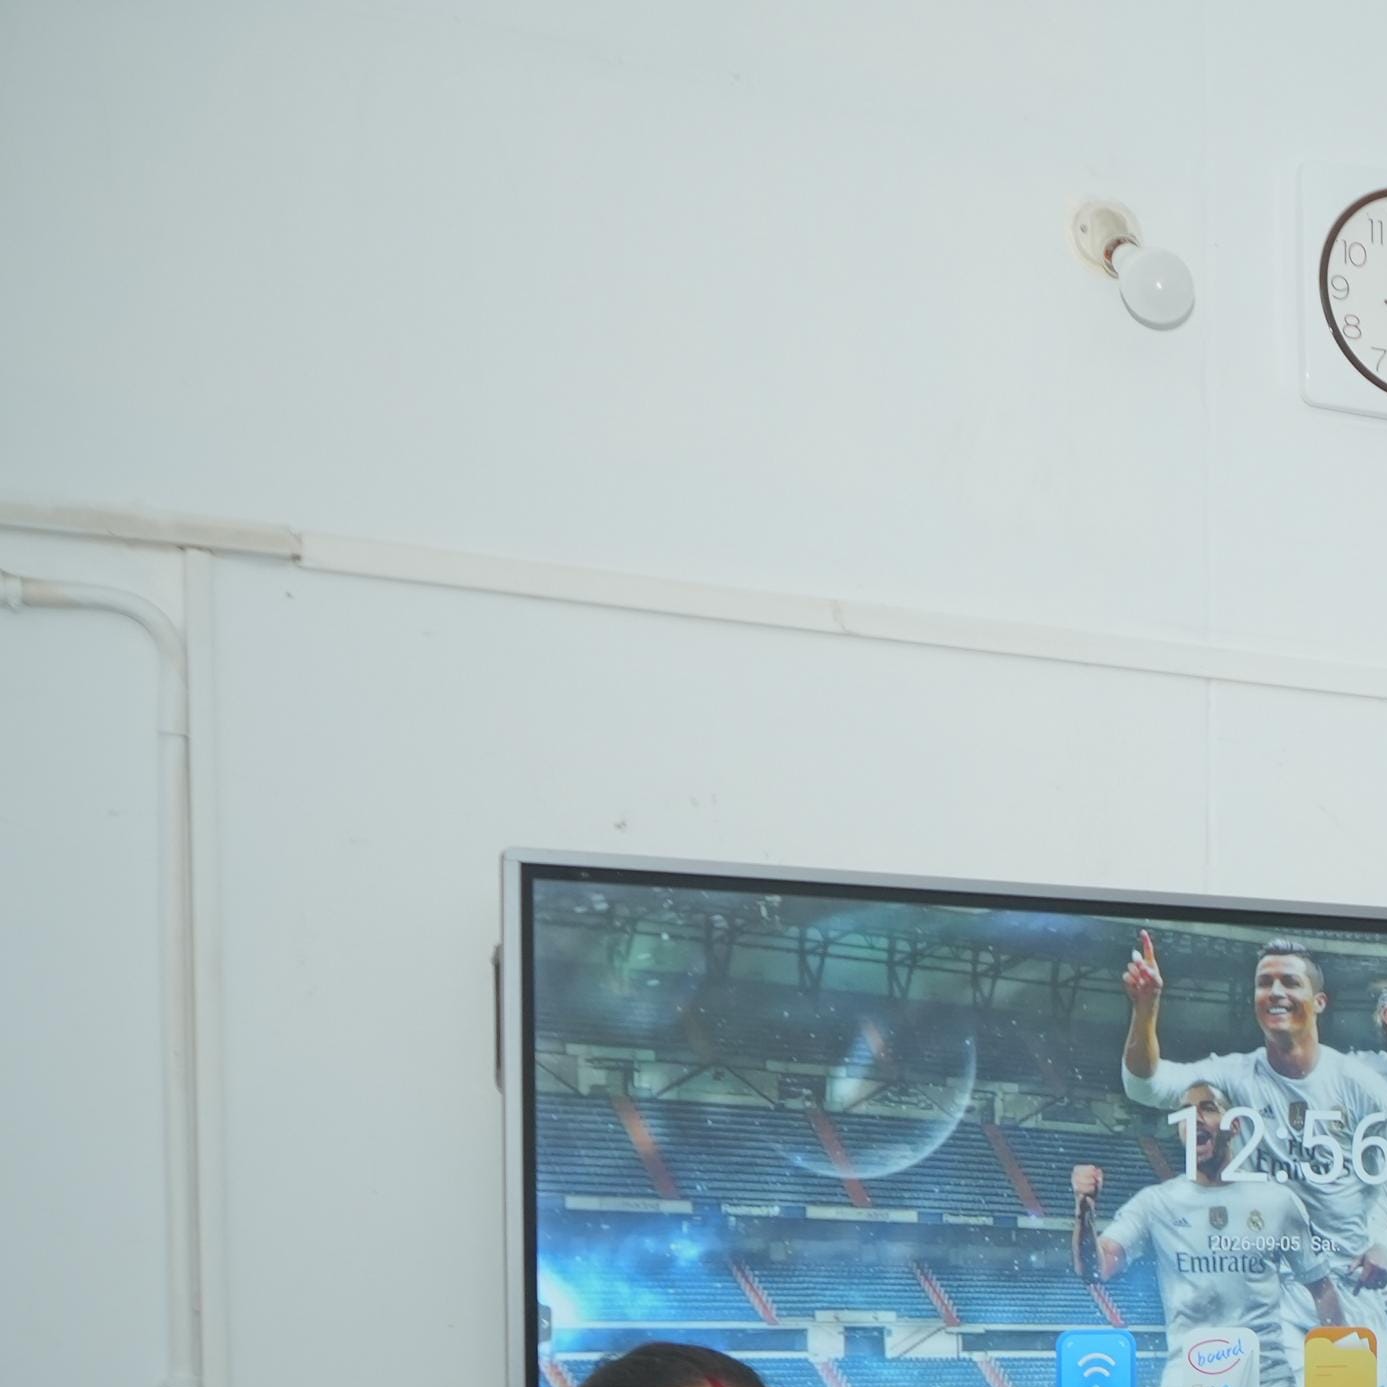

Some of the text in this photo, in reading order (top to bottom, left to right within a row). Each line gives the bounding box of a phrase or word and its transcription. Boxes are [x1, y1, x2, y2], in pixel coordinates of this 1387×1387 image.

[1368, 218, 1383, 245] 11
[1342, 239, 1367, 267] 10
[1331, 274, 1350, 300] 9
[1343, 314, 1362, 339] 8
[1371, 346, 1387, 372] 7
[1211, 1235, 1300, 1251] 2026-09-05
[1176, 1251, 1266, 1273] Emirates
